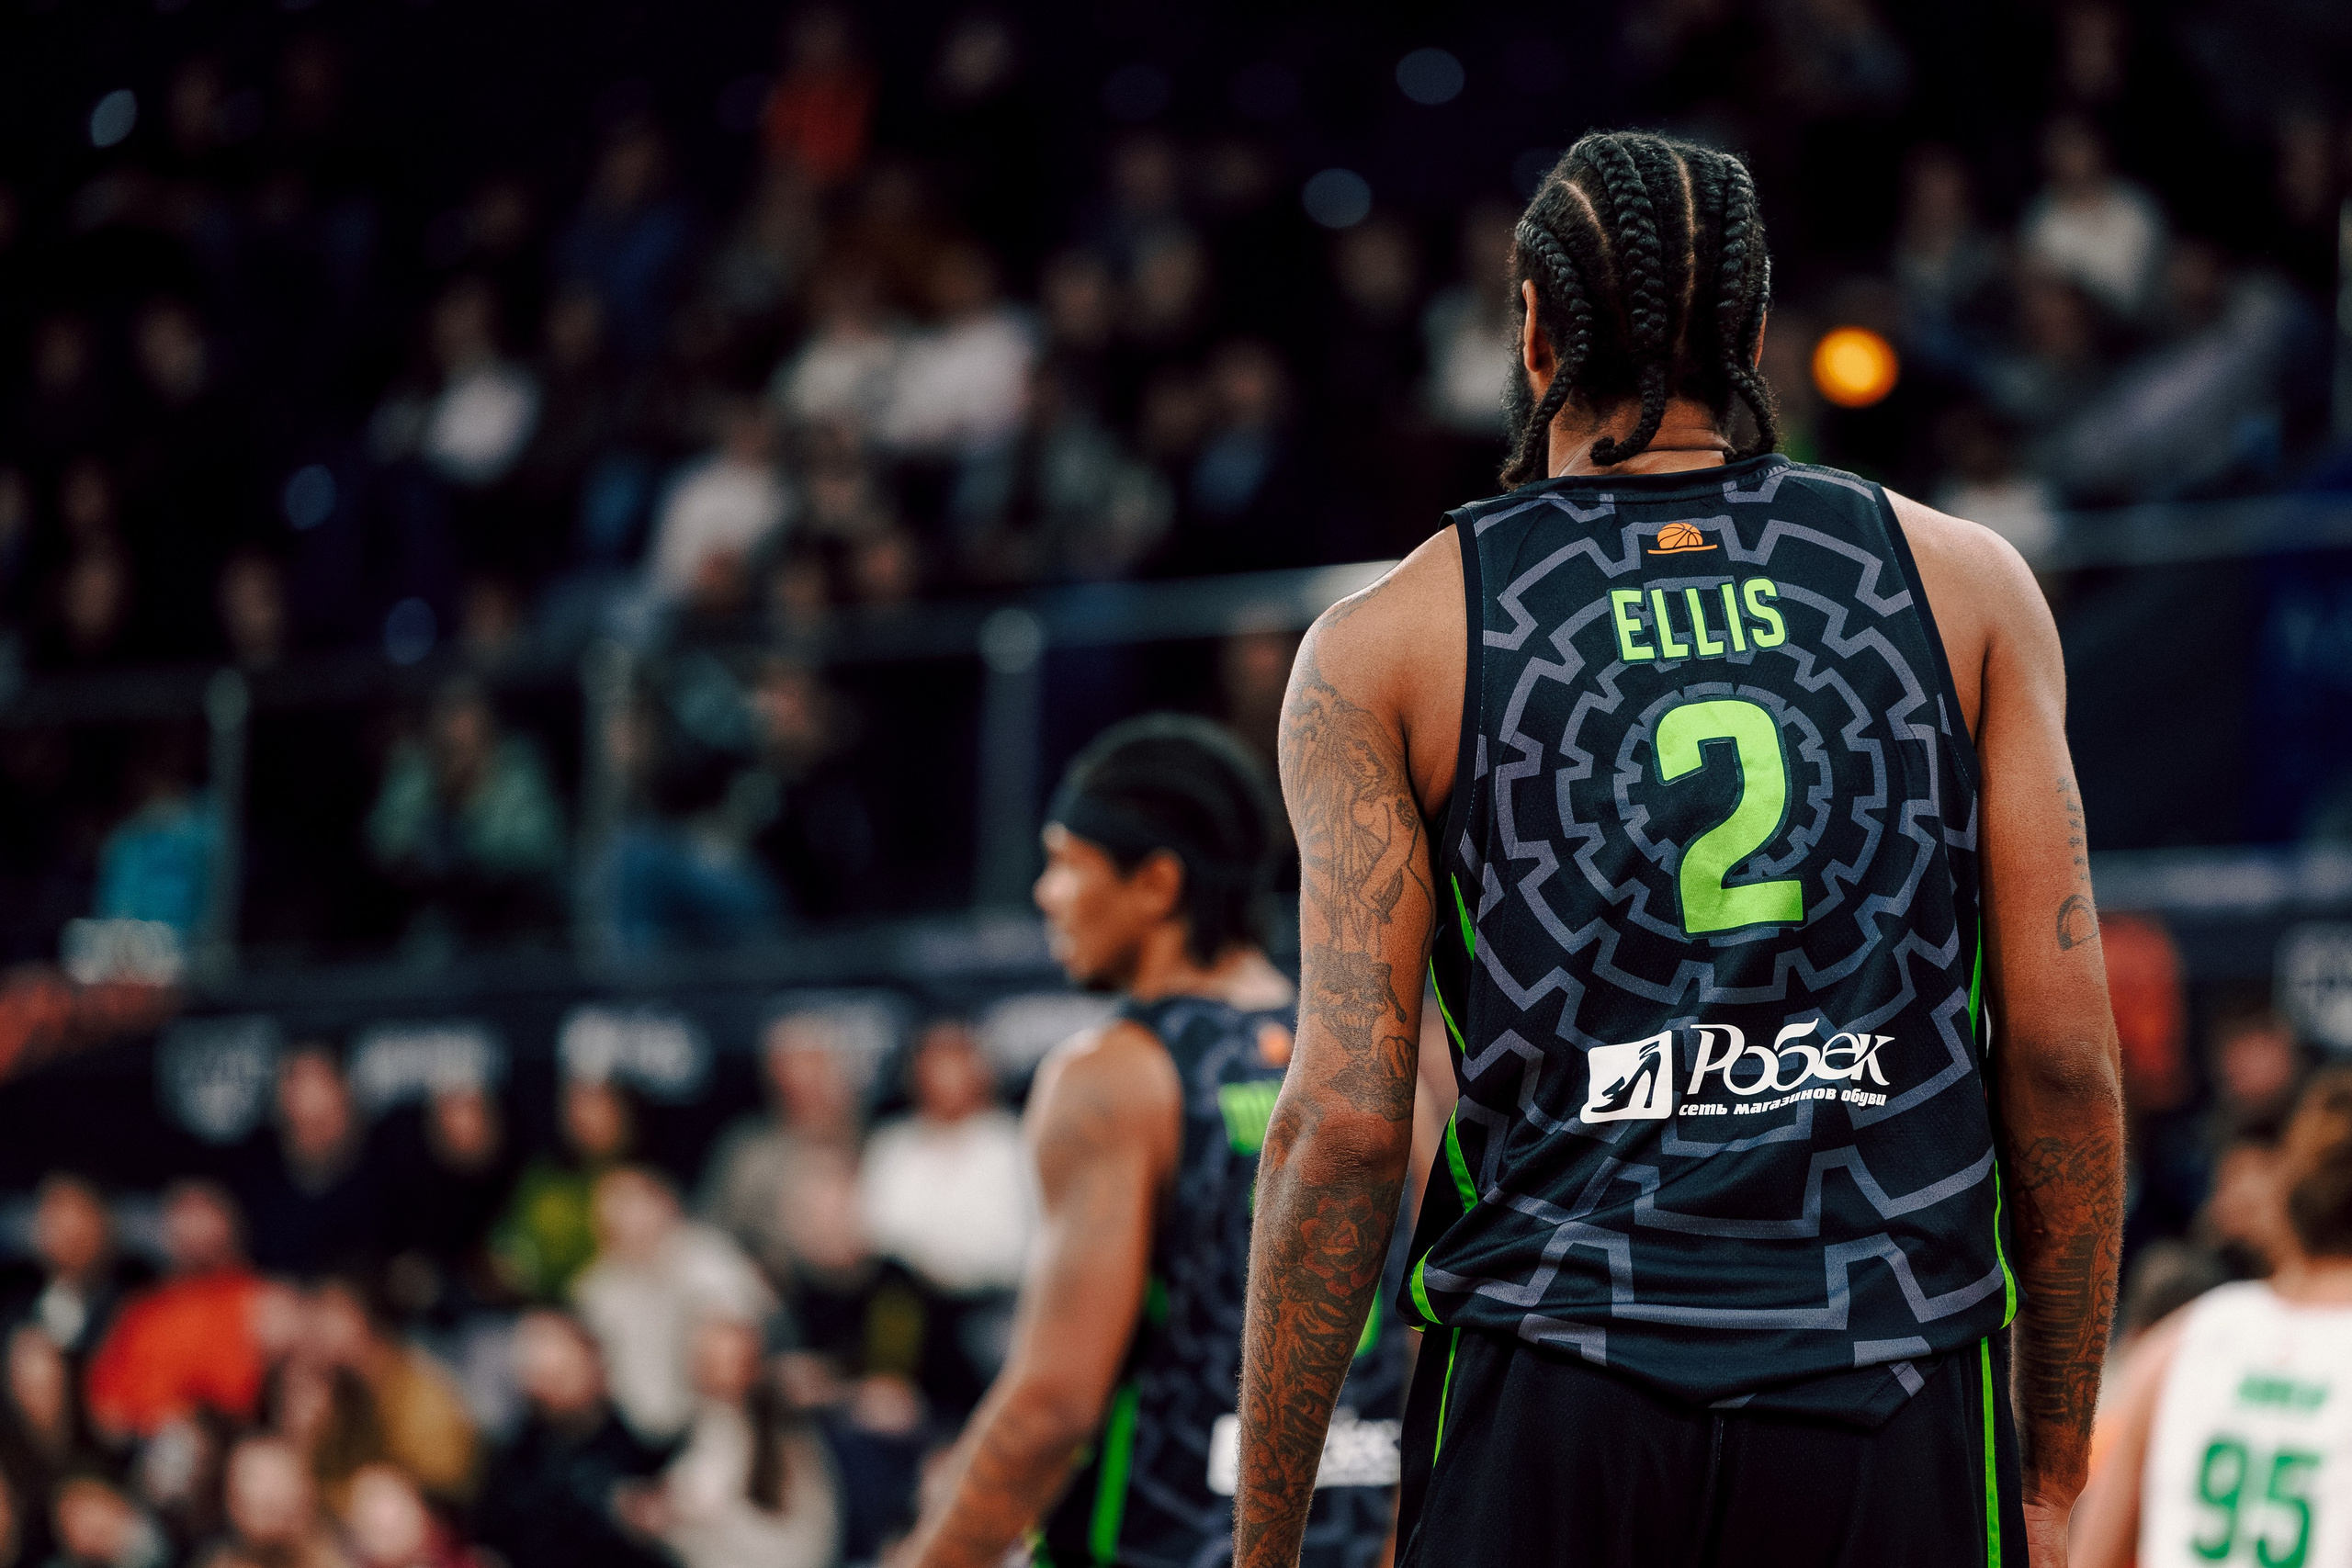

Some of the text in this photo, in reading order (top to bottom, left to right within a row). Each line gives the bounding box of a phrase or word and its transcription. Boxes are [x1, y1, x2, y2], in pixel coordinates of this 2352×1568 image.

[1611, 577, 1788, 662] ELLIS
[1655, 699, 1804, 935] 2
[1687, 1018, 1896, 1096] Робек
[1679, 1088, 1887, 1116] сеть магазинов обуви
[2194, 1440, 2321, 1568] 95
